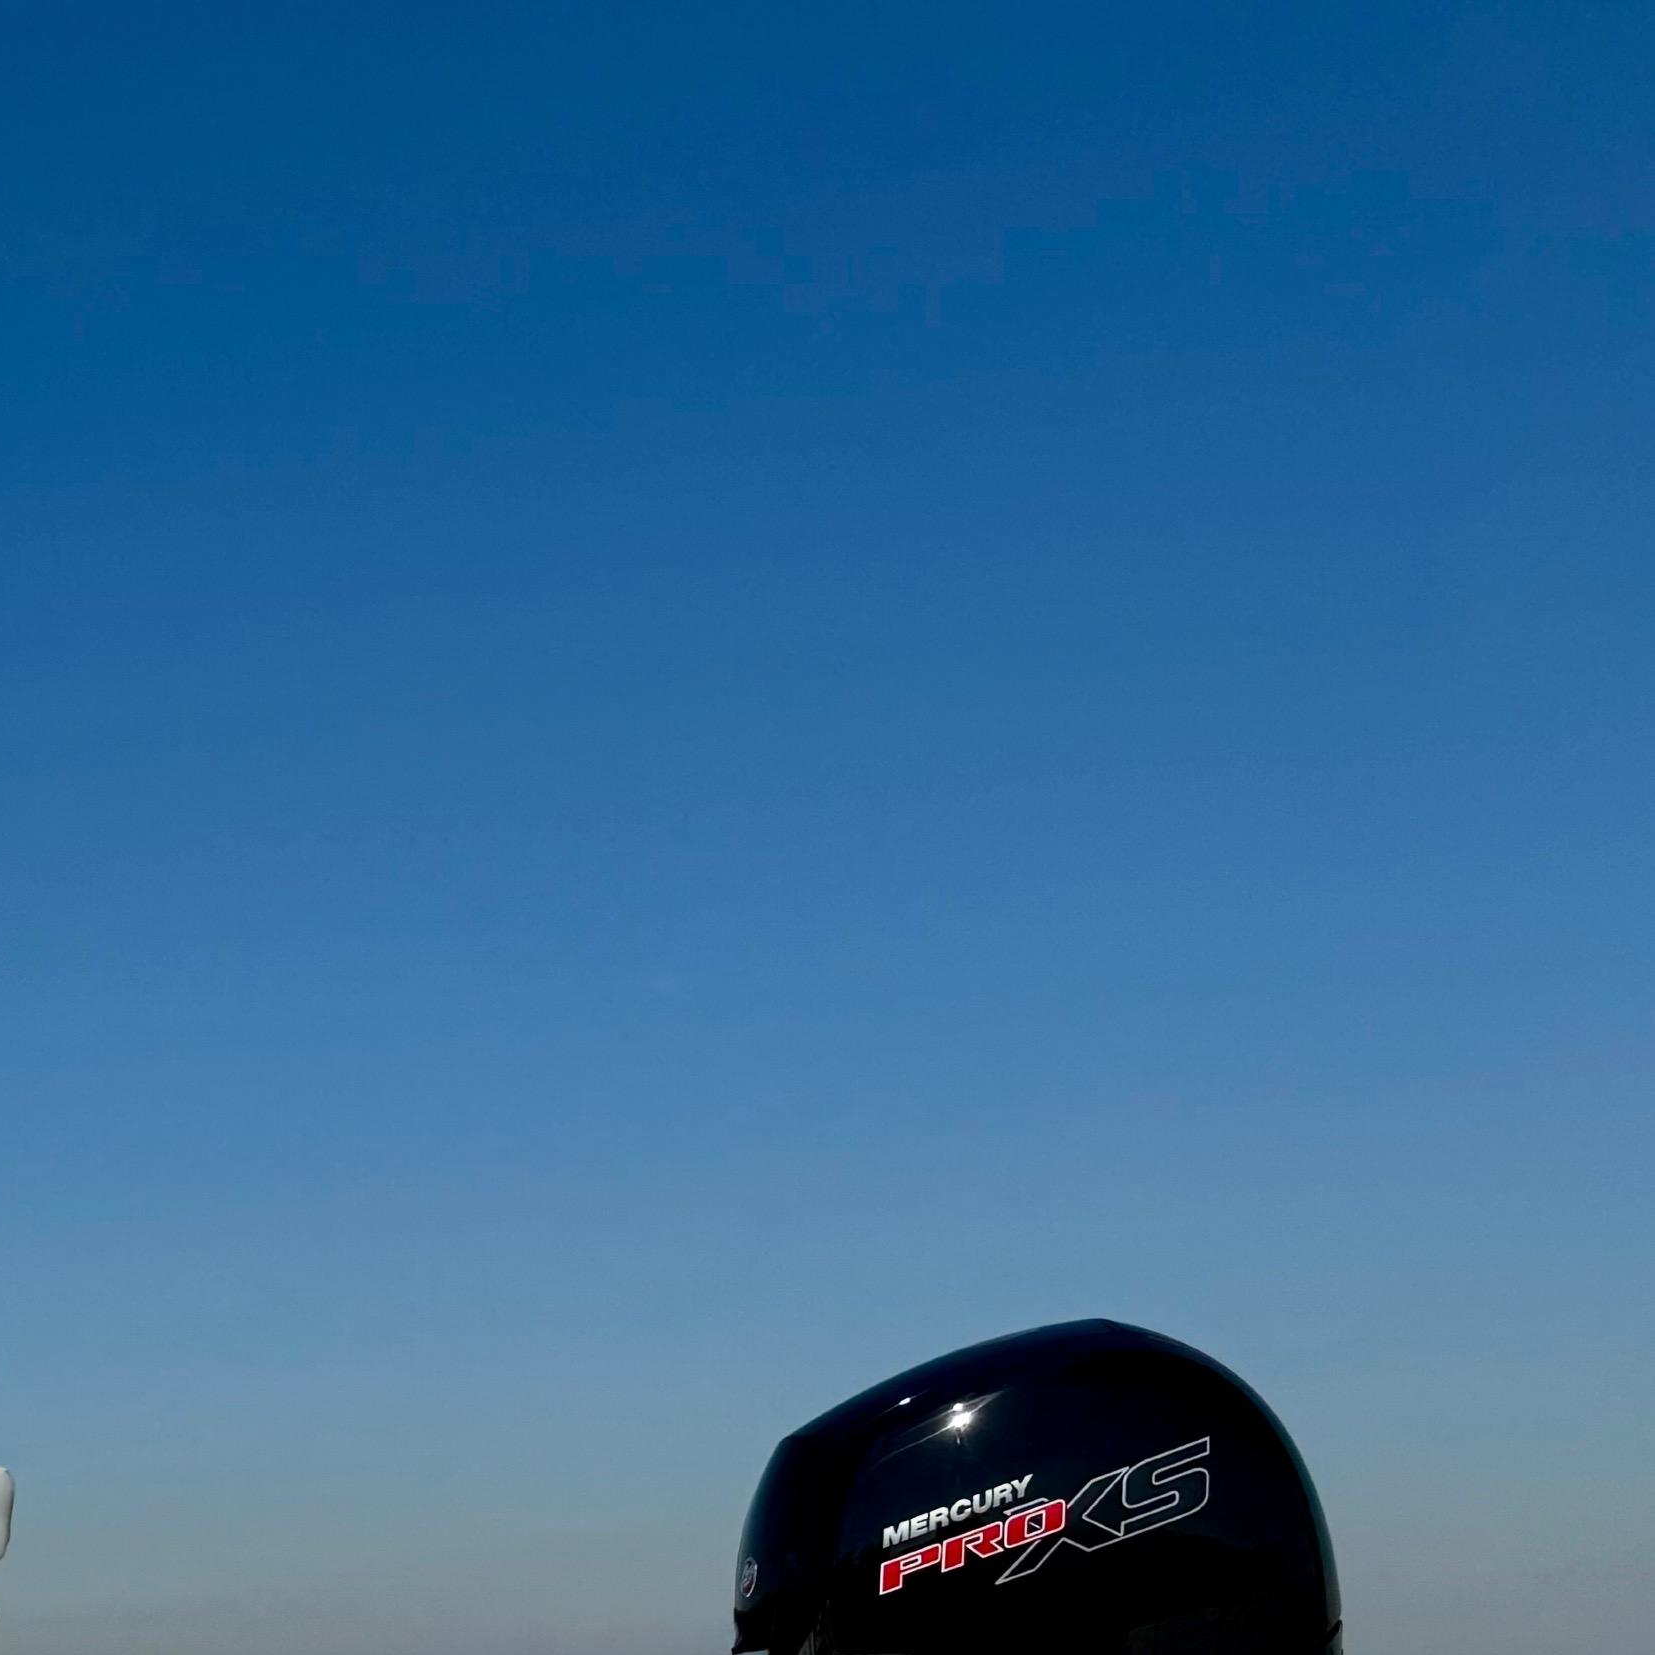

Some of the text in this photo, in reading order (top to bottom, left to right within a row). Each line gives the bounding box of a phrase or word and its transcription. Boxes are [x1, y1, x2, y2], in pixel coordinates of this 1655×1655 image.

[878, 1436, 1211, 1596] PRO XS
[882, 1474, 1034, 1549] MERCURY
